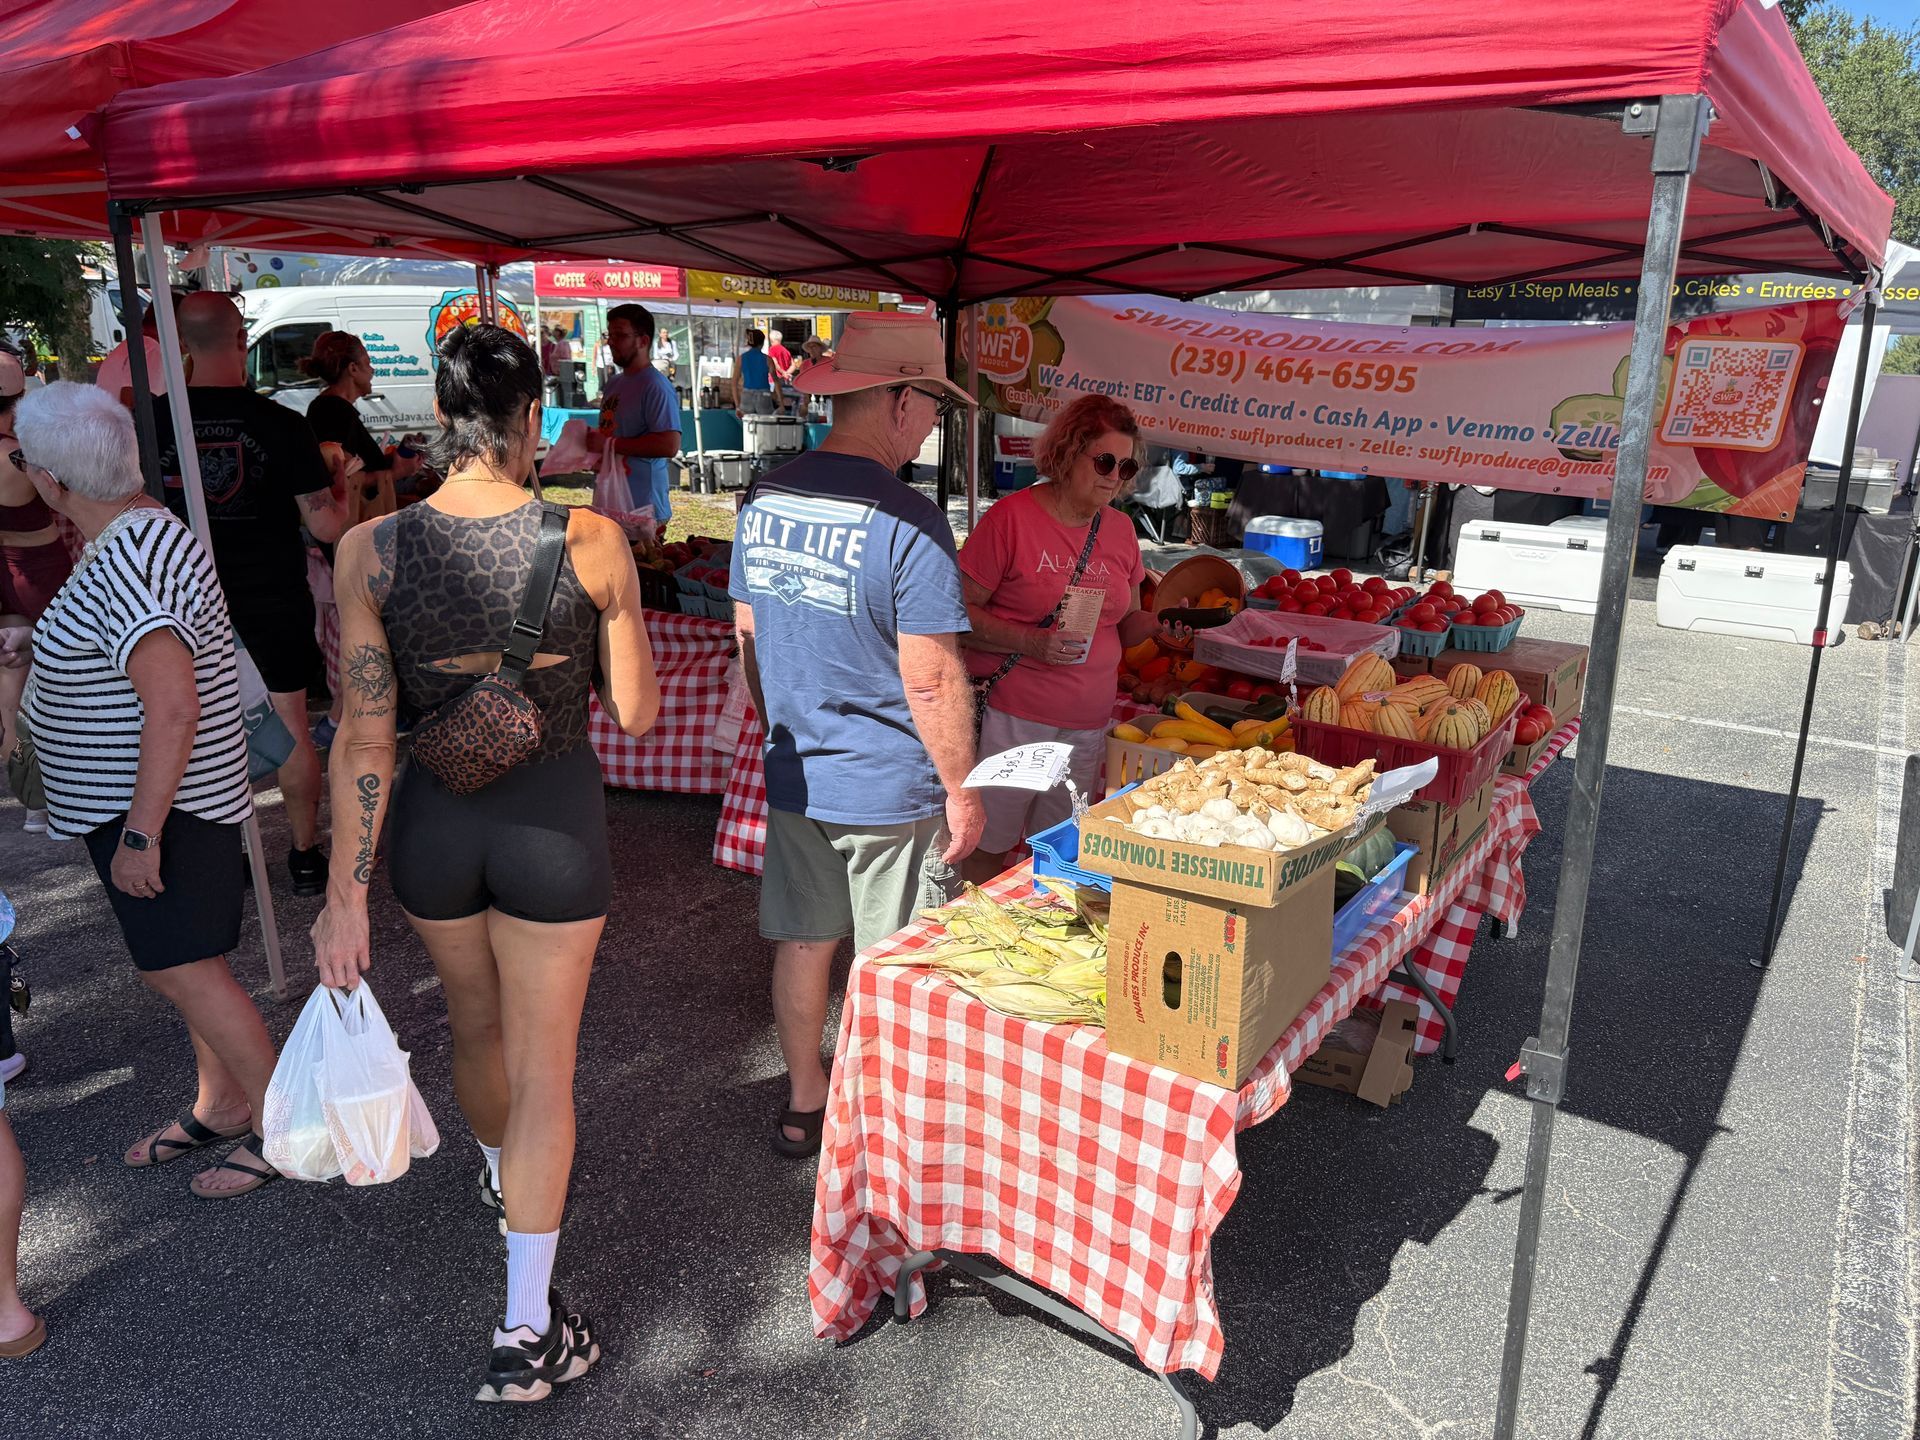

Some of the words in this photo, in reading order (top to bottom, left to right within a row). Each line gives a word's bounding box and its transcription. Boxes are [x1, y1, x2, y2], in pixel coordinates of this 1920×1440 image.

[553, 273, 586, 288] COFFEE
[604, 272, 632, 289] COLD
[633, 272, 662, 289] BREW
[722, 274, 772, 295] COFFEE
[799, 282, 833, 301] COLD
[836, 284, 871, 304] BREW
[1508, 283, 1563, 302] 1-Step
[1568, 282, 1619, 297] Meals
[1685, 280, 1740, 297] Cakes
[1759, 281, 1836, 299] Entrées
[1113, 308, 1523, 356] SWFLPRODUCE.COM
[1170, 342, 1247, 384] (239)
[1254, 355, 1418, 394] 464-6595
[1006, 389, 1036, 407] Cash
[1037, 395, 1064, 412] App:
[1039, 365, 1064, 388] We
[1066, 372, 1129, 398] Accept:
[1133, 383, 1167, 404] EBT
[1180, 389, 1240, 414] Credit
[1244, 398, 1295, 420] Card
[1312, 404, 1369, 429] Cash
[1373, 410, 1423, 438] App
[1446, 415, 1535, 443] Venmo
[1557, 424, 1621, 448] Zelle
[363, 413, 435, 425] JimmysJava.co
[195, 425, 235, 438] GOOD
[237, 431, 269, 463] BOYS
[1168, 416, 1226, 438] Venmo:
[1229, 427, 1343, 450] swflproduce1
[1359, 438, 1413, 459] Zelle:
[742, 510, 796, 549] SALT
[803, 524, 868, 569] LIFE
[1036, 549, 1111, 575] ALAKA
[1067, 586, 1105, 596] BREAKFAST
[1083, 832, 1166, 871] TOMATOES
[1171, 851, 1265, 889] TENNESSEE
[1137, 921, 1150, 940] INC
[1131, 939, 1143, 983] PRODUCE
[1131, 984, 1146, 1025] LINARES
